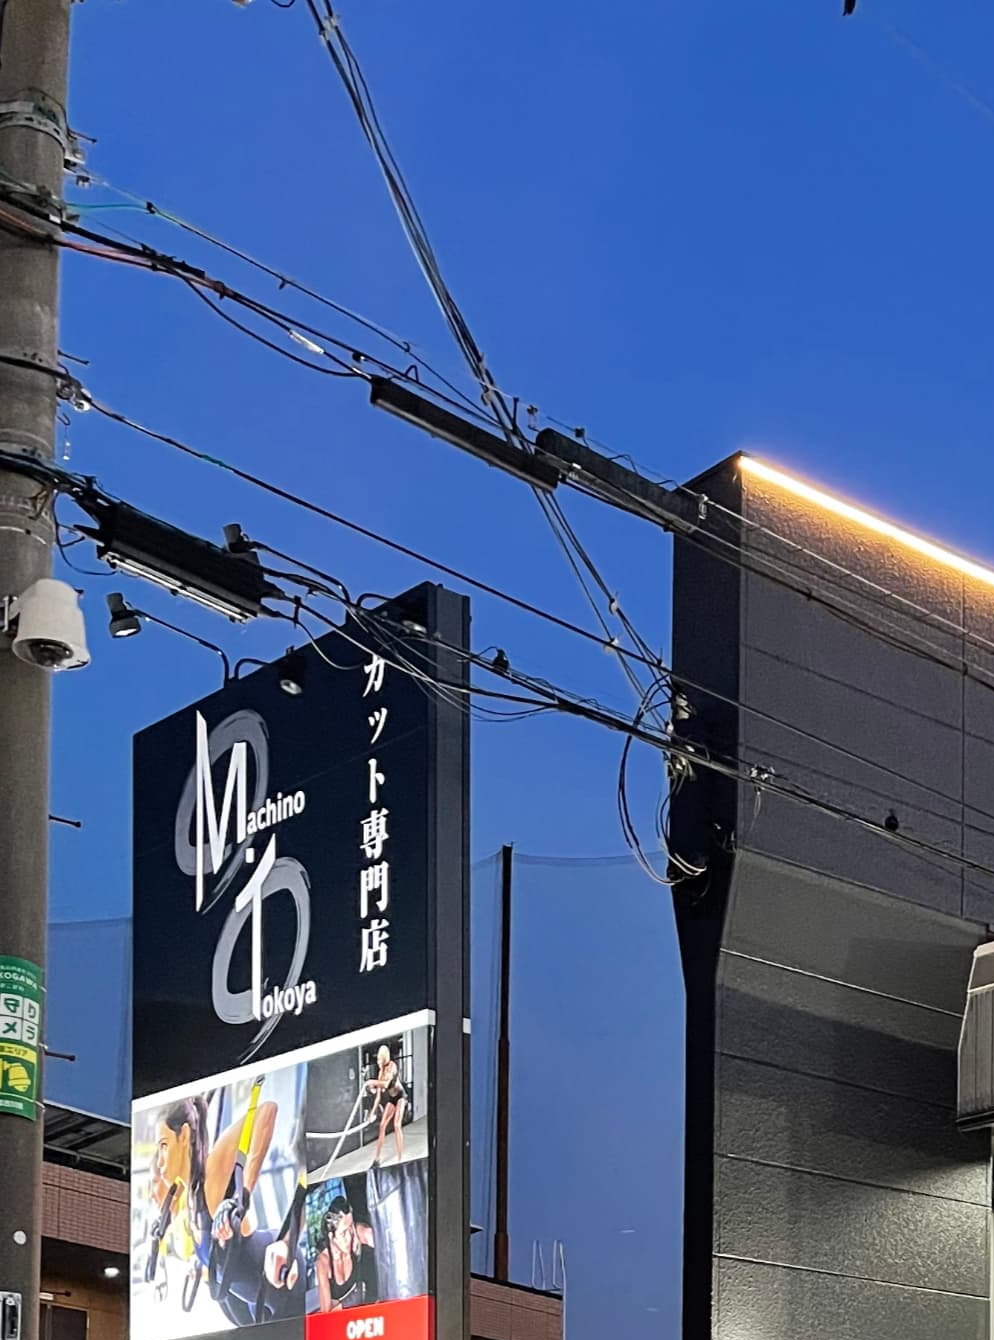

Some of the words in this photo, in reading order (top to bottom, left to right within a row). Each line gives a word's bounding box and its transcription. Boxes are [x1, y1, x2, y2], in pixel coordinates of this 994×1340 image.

[196, 710, 306, 912] Machino
[359, 653, 391, 974] カット専門店
[346, 1316, 385, 1340] OPEN
